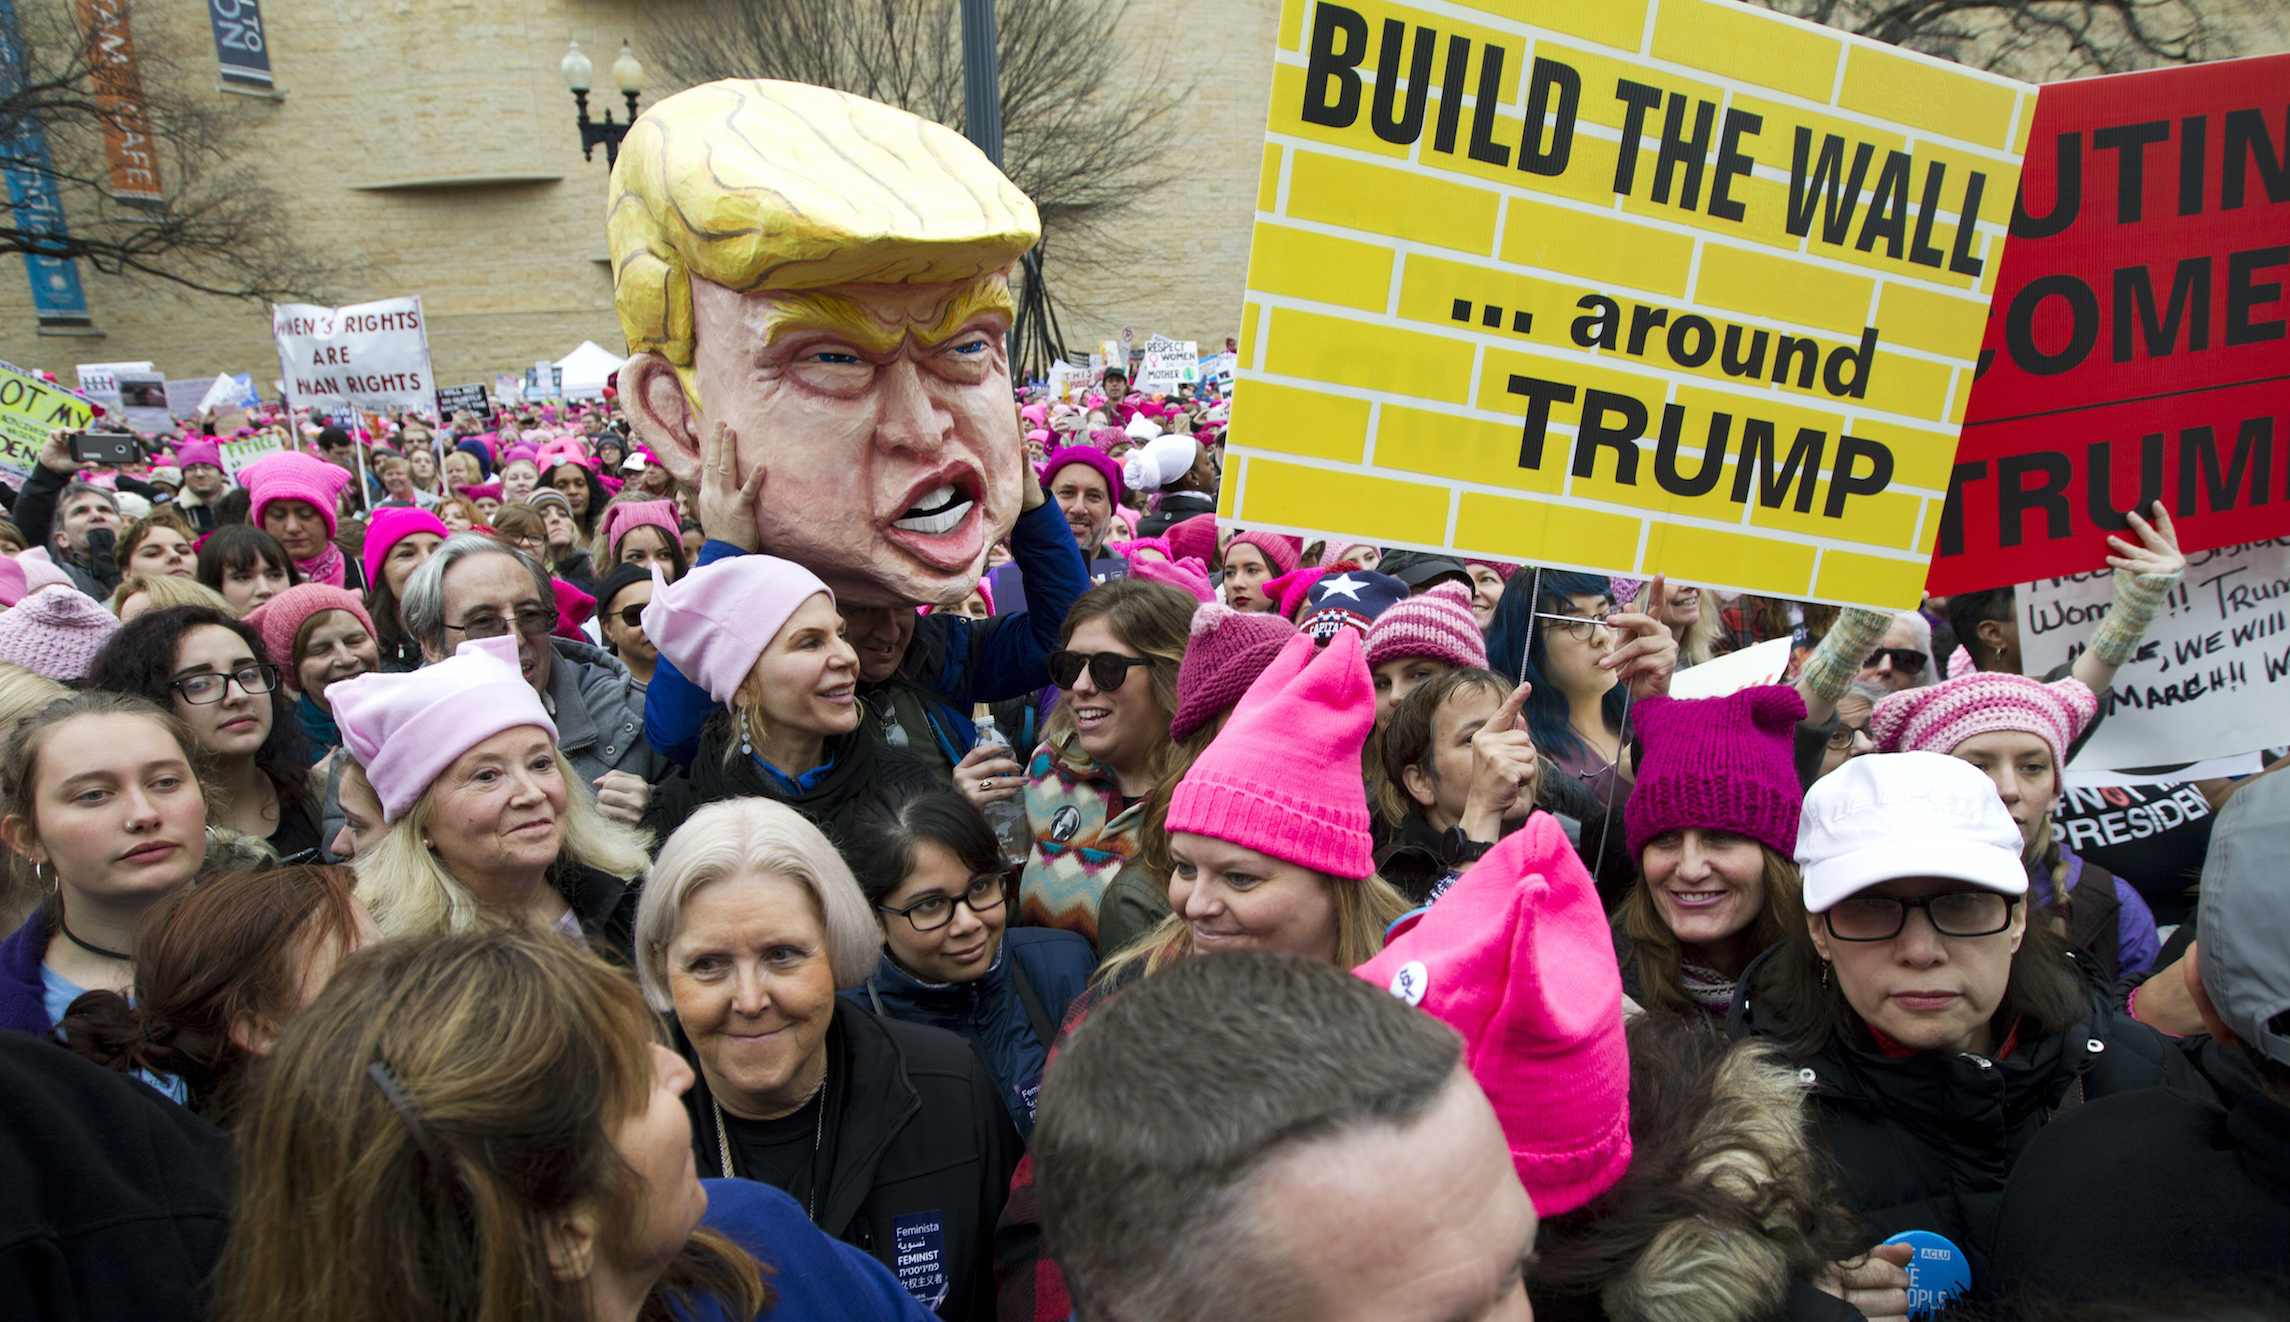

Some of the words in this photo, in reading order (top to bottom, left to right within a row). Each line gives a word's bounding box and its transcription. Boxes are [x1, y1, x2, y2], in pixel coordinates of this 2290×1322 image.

[241, 15, 263, 53] TO
[1301, 1, 1581, 177] BUILD
[1612, 79, 1763, 223] THE
[1787, 127, 1986, 278] WALL
[345, 311, 419, 334] RIGHTS
[313, 346, 350, 366] ARE
[1147, 341, 1185, 353] RESPECT
[1161, 352, 1196, 361] WOMEN
[1571, 294, 1879, 399] around
[346, 373, 421, 394] RIGHTS
[1148, 370, 1180, 380] MOTHER
[46, 402, 92, 430] MY
[1508, 375, 1894, 519] TRUMP
[1940, 415, 2290, 558] TRUM
[2176, 631, 2225, 665] WE
[896, 1223, 940, 1237] Feminista
[897, 1236, 926, 1253] نسوية
[1922, 1249, 1950, 1260] ACLU
[898, 1250, 939, 1266] FEMINIST
[899, 1262, 940, 1277] פמיניסטית
[1906, 1288, 1948, 1310] OPLE
